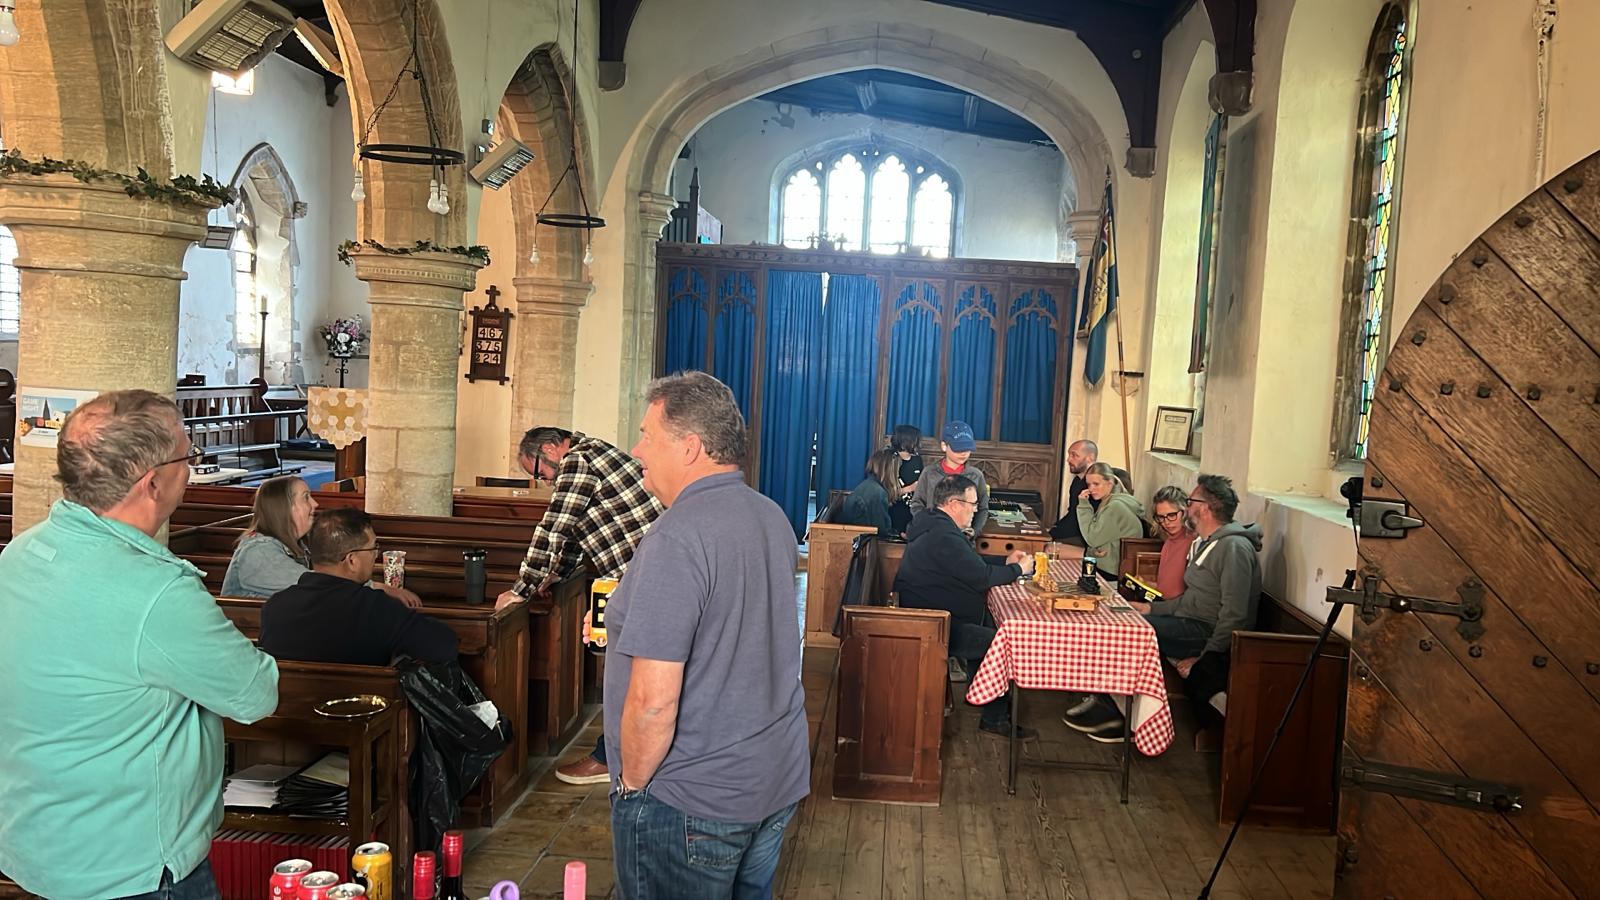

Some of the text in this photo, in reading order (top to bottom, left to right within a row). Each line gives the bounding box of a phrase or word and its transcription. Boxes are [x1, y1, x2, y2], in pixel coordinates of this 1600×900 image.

[479, 328, 504, 340] 467
[475, 341, 500, 352] 375
[474, 353, 499, 364] 224
